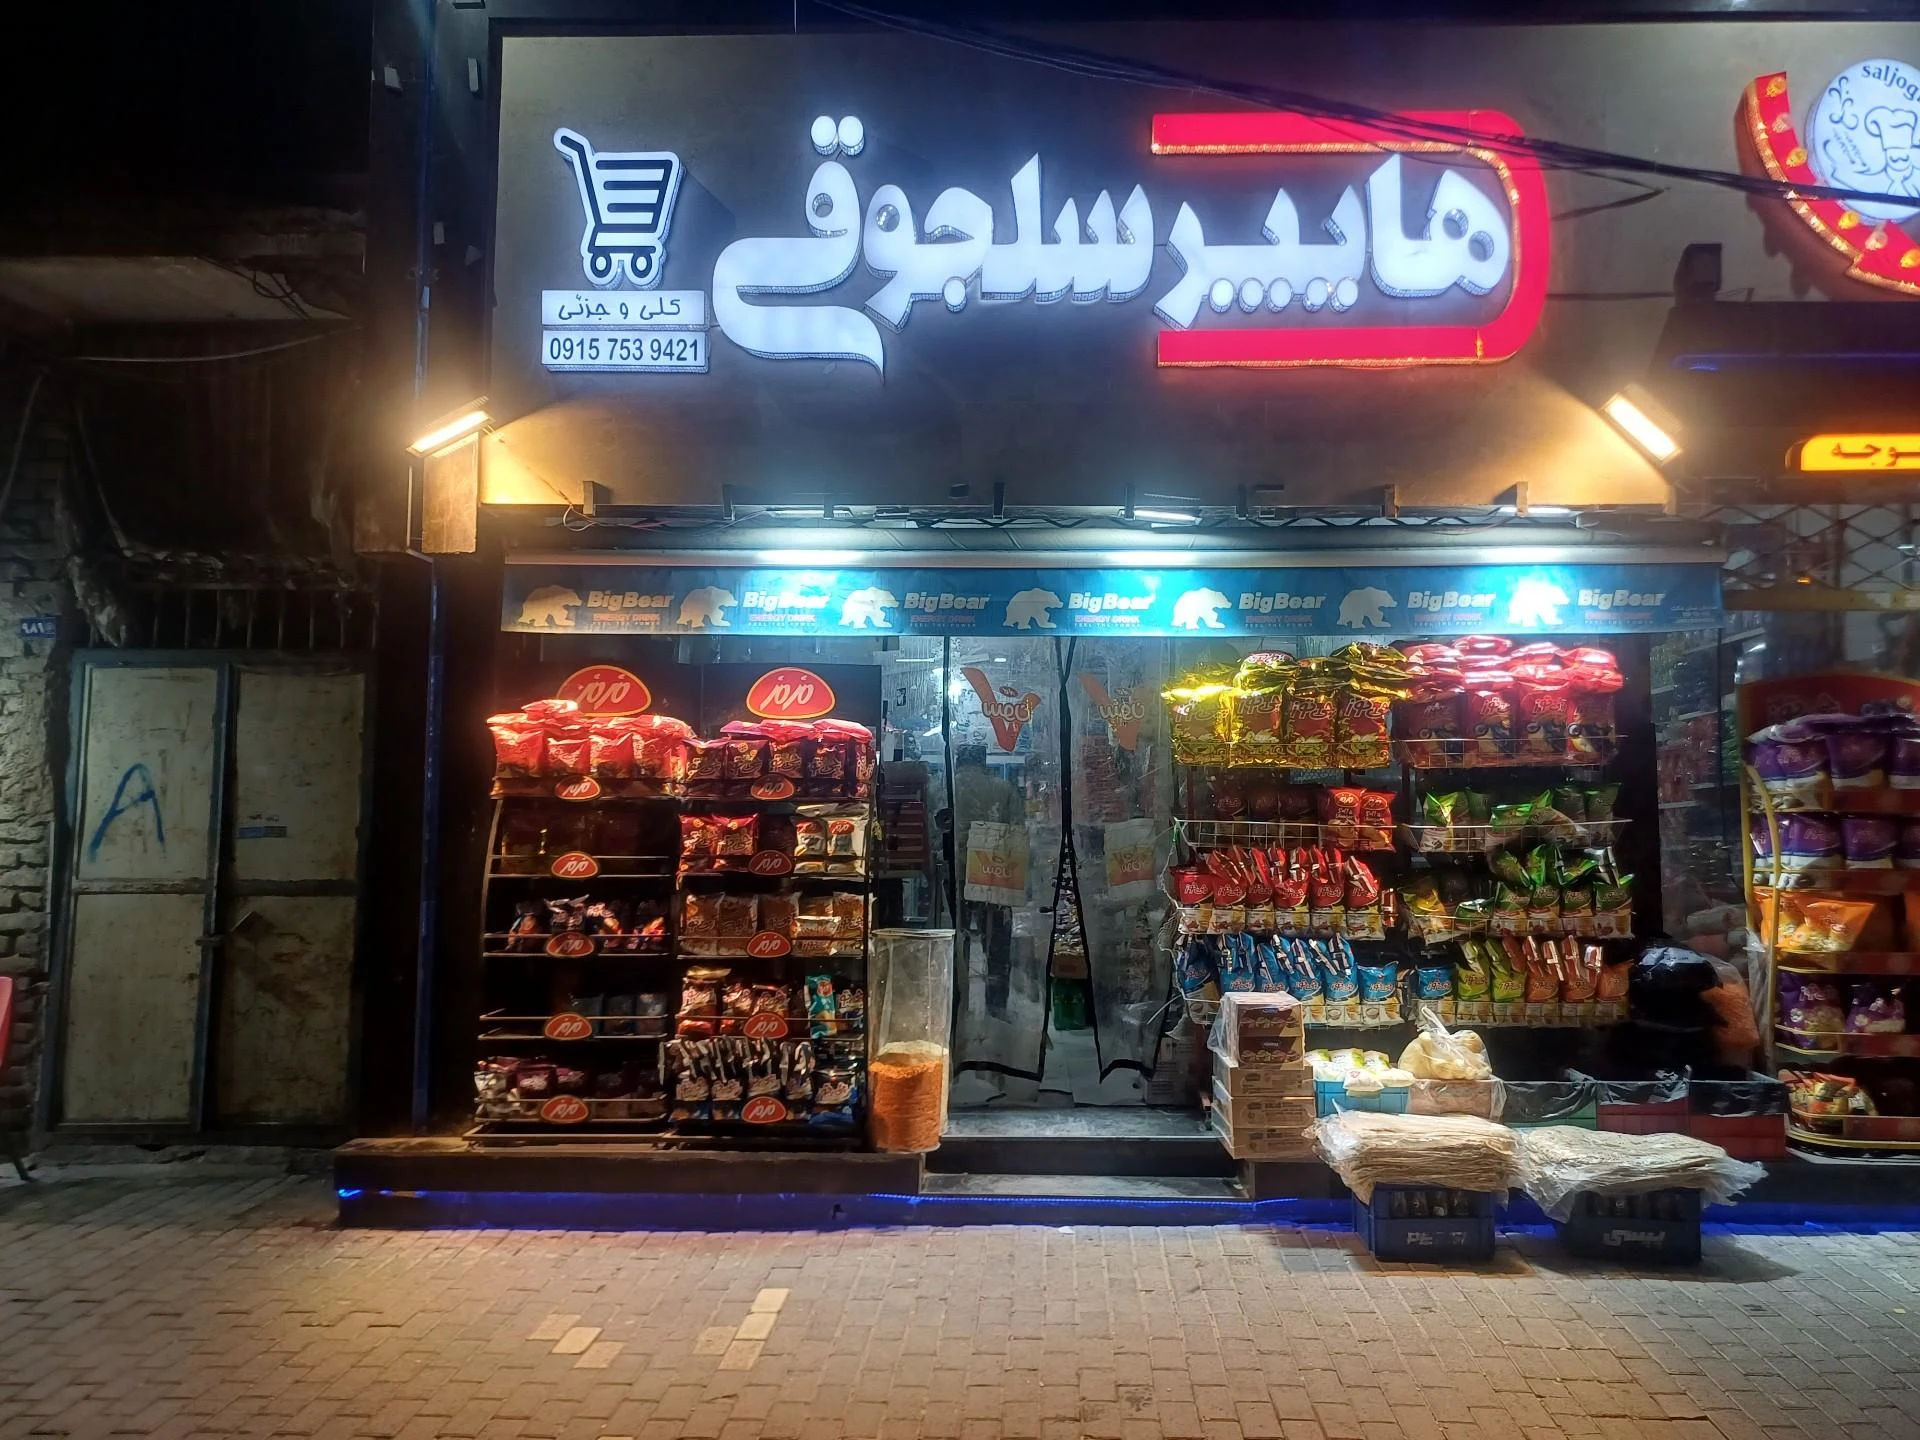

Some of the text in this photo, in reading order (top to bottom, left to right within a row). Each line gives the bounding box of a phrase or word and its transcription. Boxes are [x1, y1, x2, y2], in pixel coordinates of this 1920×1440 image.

[1861, 64, 1920, 102] saljog
[711, 115, 1511, 384] هایپر سلجوقی
[619, 302, 629, 320] و
[639, 297, 681, 320] کلی
[550, 337, 698, 362] 0915 753 9421
[1832, 442, 1920, 467] وجه
[587, 591, 675, 611] BigBear
[904, 592, 990, 613] BigBear
[1069, 592, 1155, 613] BigBear
[1239, 592, 1327, 613] BigBear
[1408, 591, 1497, 612] BigBear
[1578, 589, 1666, 610] BigBear
[576, 673, 631, 711] مزمز
[759, 675, 815, 711] مزمز
[89, 763, 165, 862] A
[559, 856, 589, 875] مزمز
[755, 853, 782, 871] مزمز
[555, 935, 585, 954] مزمز
[756, 935, 781, 954] مزمز
[553, 1018, 583, 1036] مزمز
[753, 1017, 779, 1035] مزمز
[551, 1100, 578, 1118] مزمز
[750, 1101, 776, 1119] مزمز
